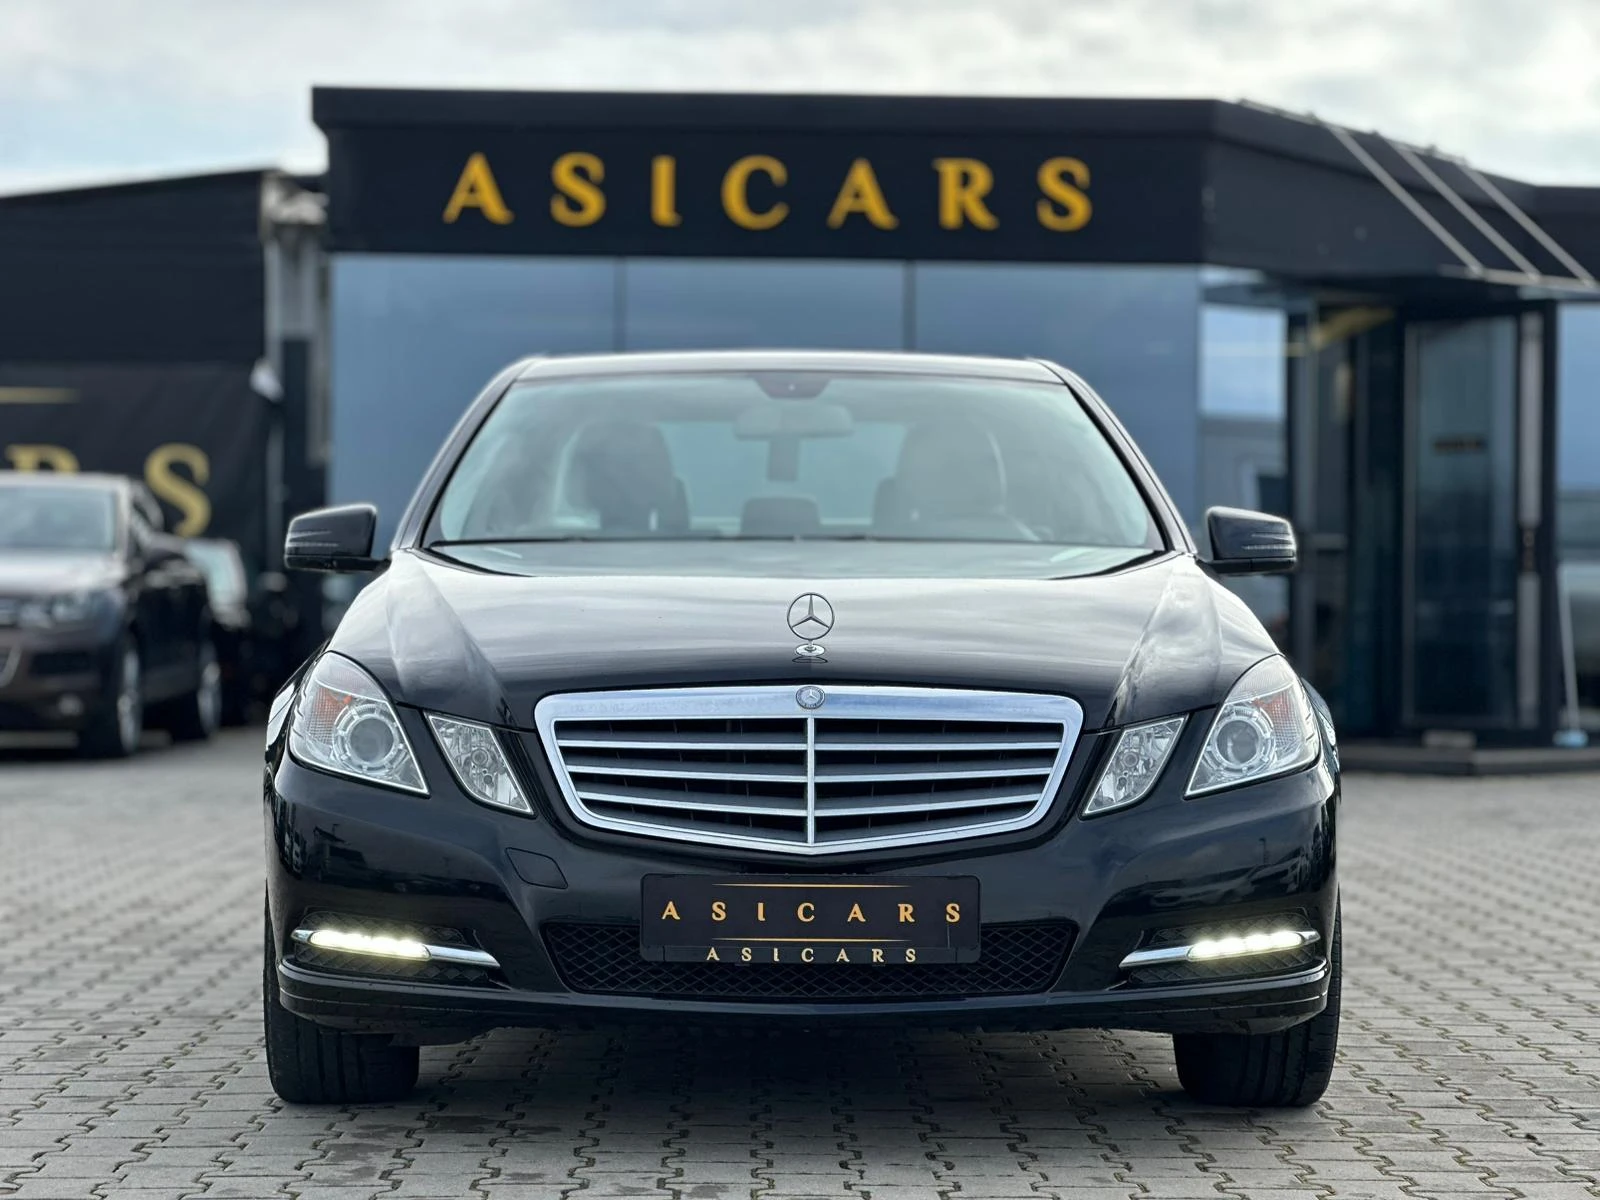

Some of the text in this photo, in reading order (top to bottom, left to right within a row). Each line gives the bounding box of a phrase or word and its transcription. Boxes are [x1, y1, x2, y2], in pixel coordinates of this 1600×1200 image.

[442, 152, 1093, 232] ASICARS
[661, 900, 961, 923] ASICARS
[706, 946, 917, 963] ASICARS
